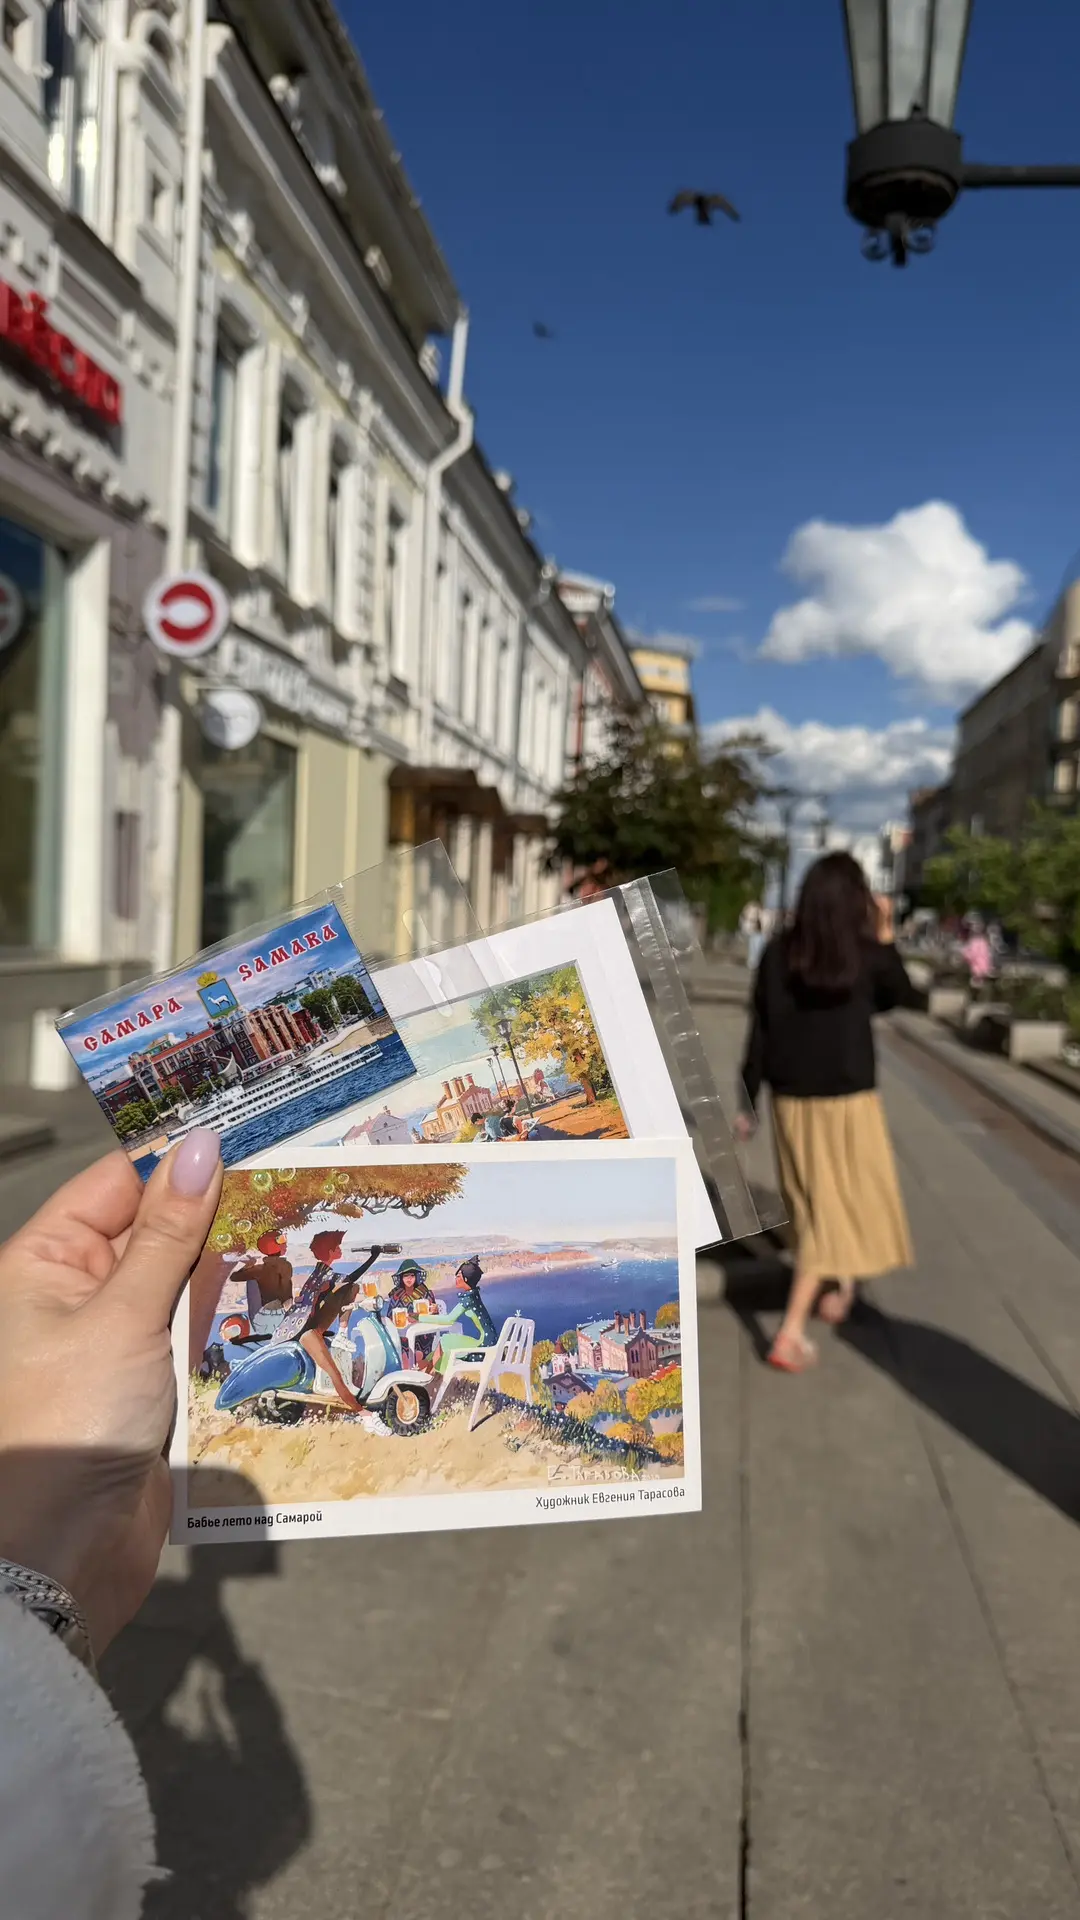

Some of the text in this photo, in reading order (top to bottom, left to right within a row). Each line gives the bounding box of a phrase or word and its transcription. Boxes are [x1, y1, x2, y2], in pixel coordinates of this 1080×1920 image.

[238, 924, 338, 982] SAMARA
[83, 996, 183, 1052] САМАРА
[535, 1486, 685, 1510] Художник Евгения Тарасова
[187, 1510, 323, 1529] Бабье лето над Самарой
